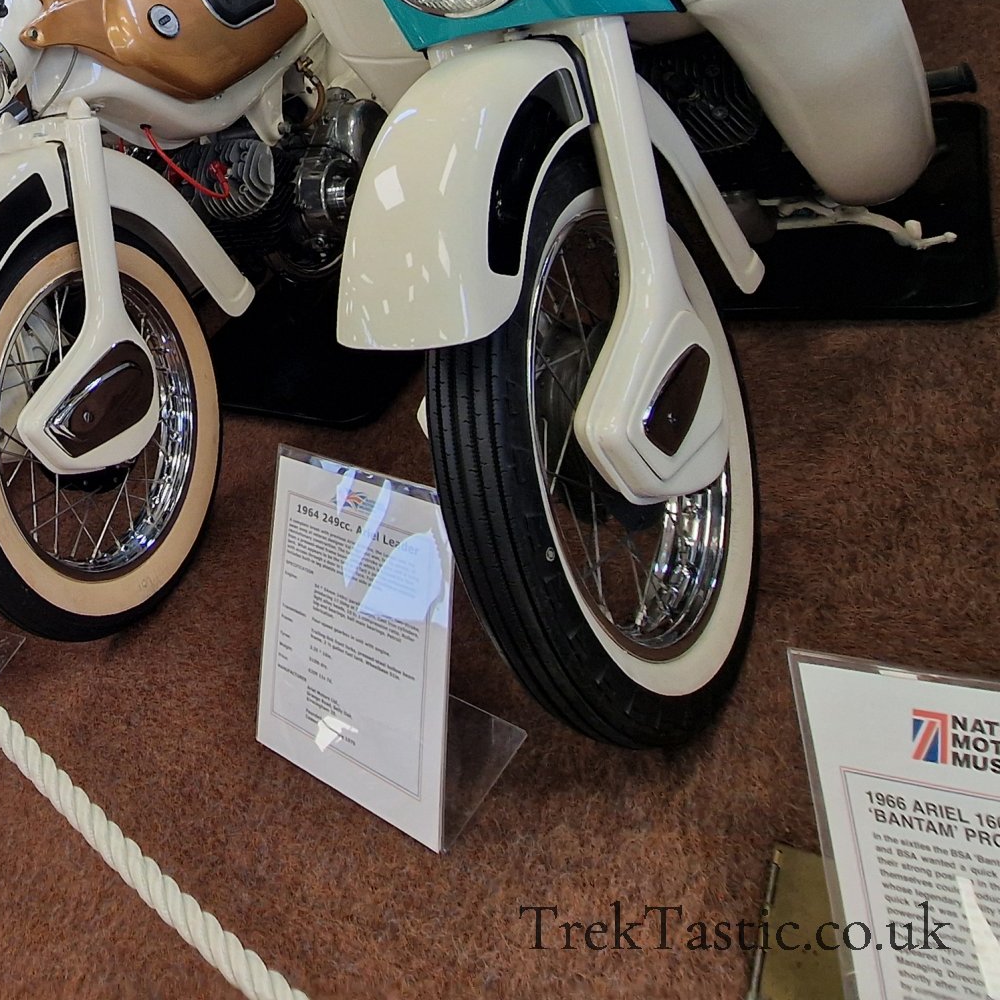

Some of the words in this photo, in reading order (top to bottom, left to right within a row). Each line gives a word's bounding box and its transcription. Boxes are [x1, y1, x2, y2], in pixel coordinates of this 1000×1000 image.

[297, 504, 319, 519] 1964
[322, 512, 353, 532] 249cc.
[865, 790, 907, 811] 1966
[912, 800, 970, 824] ARIEL
[875, 845, 892, 855] and
[896, 848, 918, 860] BSA
[920, 856, 956, 870] wanted
[970, 867, 998, 879] quick
[950, 848, 972, 861] BSA
[879, 868, 933, 888] themselves
[901, 863, 932, 878] strong
